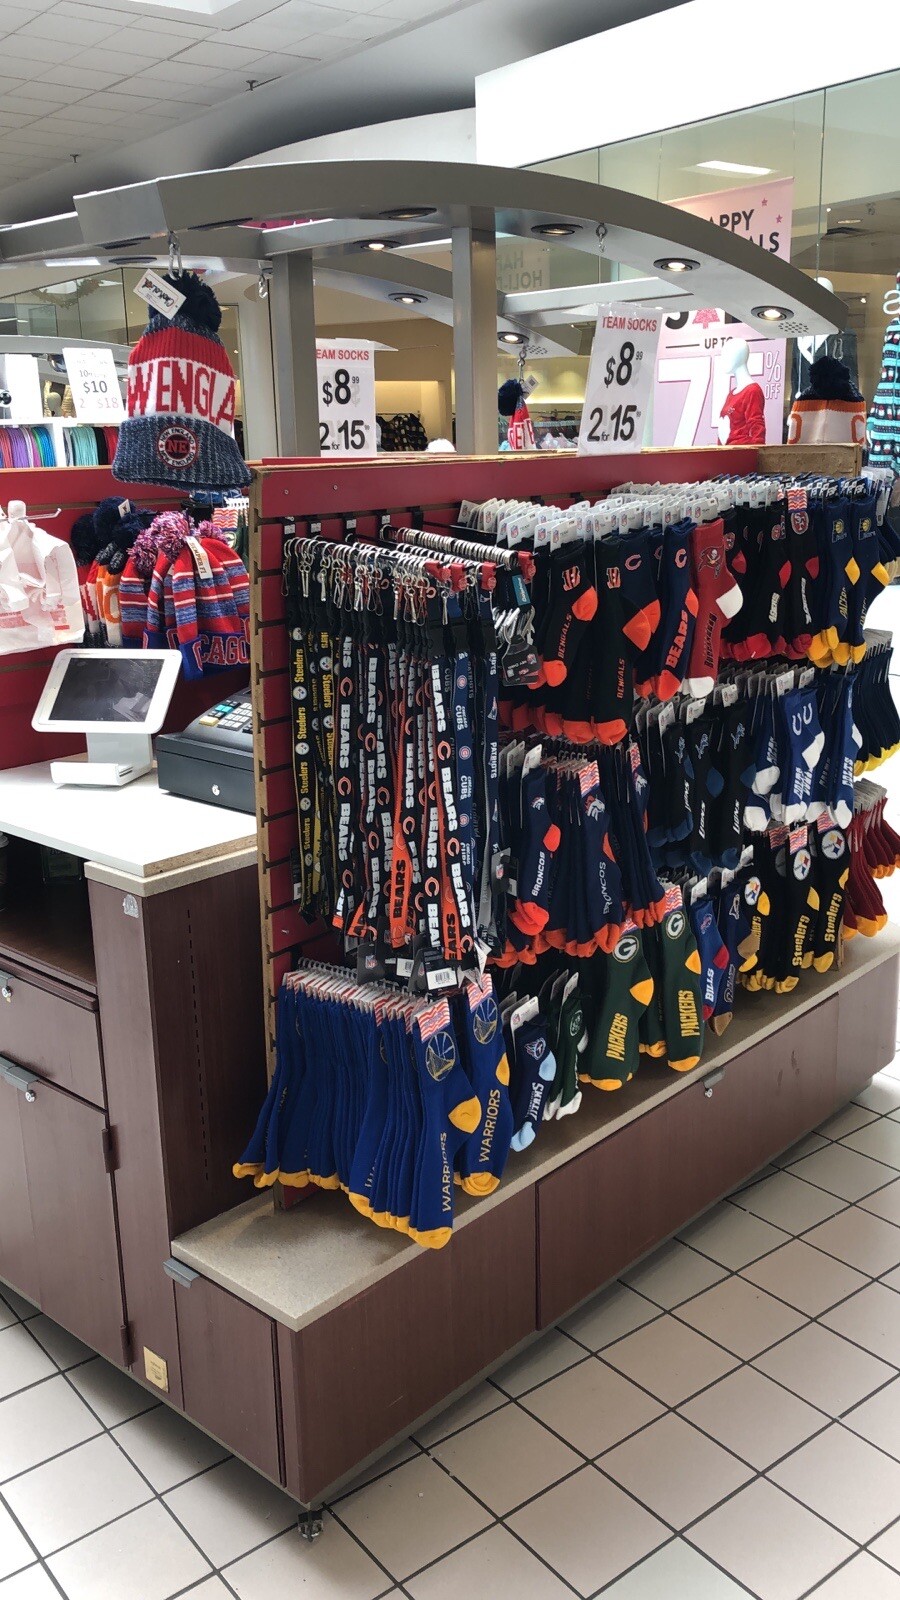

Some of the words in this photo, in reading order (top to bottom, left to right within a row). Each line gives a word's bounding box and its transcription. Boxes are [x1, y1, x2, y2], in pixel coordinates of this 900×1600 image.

[602, 316, 625, 330] TEAM
[627, 318, 657, 333] SOCKS
[704, 336, 718, 350] UP
[338, 350, 370, 361] SOCKS
[604, 341, 634, 389] $8
[80, 398, 86, 409] 2
[97, 397, 119, 409] $18
[83, 380, 108, 395] $10
[323, 369, 351, 407] $8
[352, 376, 360, 384] 99
[766, 384, 781, 401] OFF
[320, 422, 331, 451] 2
[332, 442, 341, 451] for
[338, 420, 366, 451] 15
[587, 406, 603, 442] 2
[602, 432, 611, 442] for
[611, 404, 638, 442] 15
[167, 440, 189, 453] NE
[557, 612, 573, 659] BENGALS
[665, 610, 689, 669] BEARS
[703, 612, 718, 669] BUCCANEERS
[293, 648, 304, 683] Steelers
[444, 667, 452, 693] CUBS
[616, 658, 627, 699] BENGALS
[322, 674, 334, 709] Steelers
[367, 657, 378, 724] BEARS
[431, 664, 448, 733] BEARS
[296, 707, 308, 740] Steelers
[339, 703, 351, 769] BEARS
[455, 705, 465, 731] CUBS
[461, 706, 469, 729] CHICAGO
[298, 761, 309, 795] Steelers
[405, 742, 415, 809] BEARS
[490, 741, 498, 780] PATRIOTS
[842, 756, 854, 788] COLTS
[366, 759, 377, 824] BEARS
[441, 767, 458, 832] BEARS
[460, 775, 468, 801] CUBS
[303, 817, 312, 851] Steelers
[338, 803, 351, 862] BEARS
[698, 800, 706, 840] LIONS
[733, 799, 741, 835] LIONS
[427, 807, 439, 869] BEARS
[367, 856, 381, 919] BEARS
[393, 860, 407, 918] BEARS
[531, 851, 546, 897] BRONCOS
[598, 861, 611, 915] BRONCOS
[451, 862, 472, 928] BEARS
[427, 903, 442, 948] BEA
[824, 892, 843, 943] Steelers
[792, 914, 811, 967] Steelers
[705, 967, 715, 1002] BILLS
[678, 990, 700, 1037] PACKERS
[605, 1013, 628, 1062] PACKERS
[530, 1082, 545, 1121] TITANS
[479, 1088, 501, 1163] WARRIORS
[440, 1132, 453, 1213] WARRIORS
